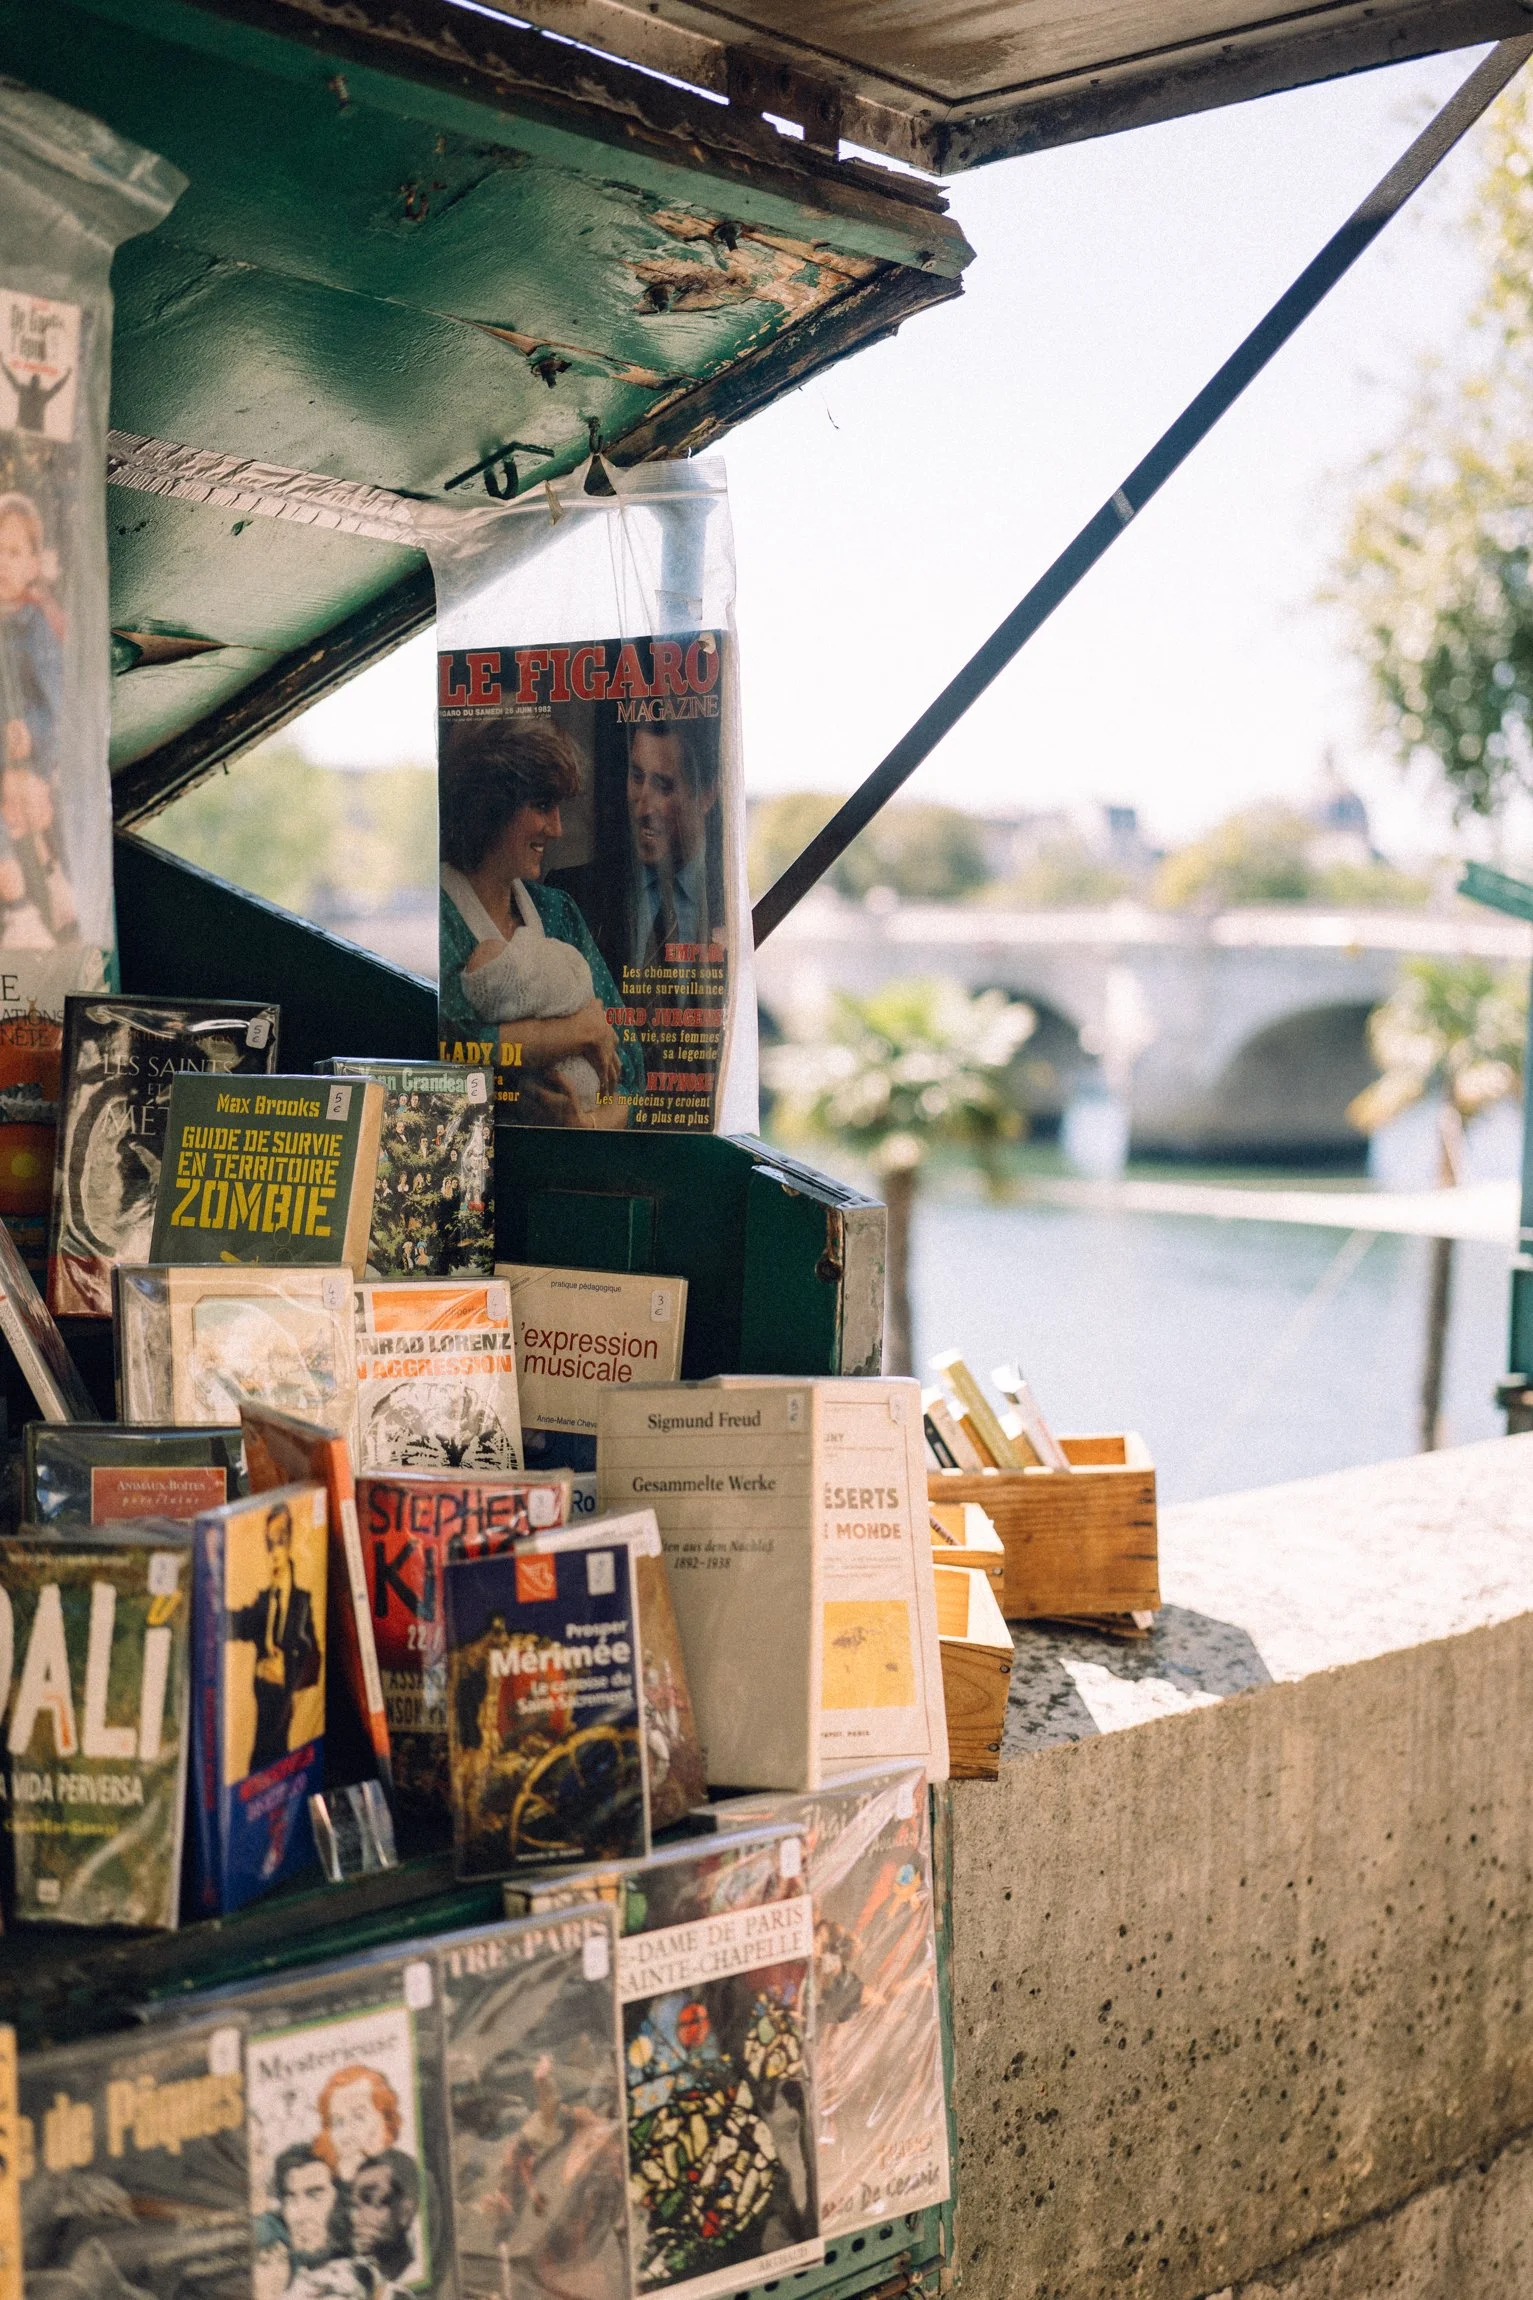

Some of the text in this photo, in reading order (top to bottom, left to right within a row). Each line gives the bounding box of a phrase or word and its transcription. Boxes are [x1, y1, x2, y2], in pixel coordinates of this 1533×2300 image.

[438, 640, 720, 707] LE FIGARO
[475, 708, 502, 716] SAMEDI
[515, 706, 532, 714] JUIN
[534, 705, 551, 713] 1982
[616, 695, 720, 723] MAGAZINE
[622, 965, 641, 978] Les
[699, 968, 724, 978] sous
[622, 982, 724, 995] haute surveillance
[605, 1007, 647, 1026] CURD
[623, 1029, 636, 1042] Sa
[680, 1030, 720, 1043] femmes
[439, 1041, 522, 1066] LADY DI
[662, 1050, 674, 1060] sa
[103, 1054, 140, 1077] LES
[470, 1078, 478, 1088] 5
[646, 1072, 715, 1091] HYPNOSE
[216, 1093, 321, 1118] Max Brooks
[334, 1092, 343, 1102] 5
[595, 1093, 614, 1105] Les
[666, 1096, 673, 1109] y
[675, 1095, 710, 1107] croient
[635, 1110, 709, 1126] de plus en plus
[181, 1126, 343, 1157] GUIDE DE SURVIE
[177, 1151, 340, 1186] EN TERRITOIRE
[170, 1178, 337, 1237] ZOMBIE
[550, 1280, 622, 1293] pratique pédagogique
[657, 1295, 664, 1306] 3
[428, 1333, 512, 1353] LORENZ
[372, 1355, 512, 1379] AGGRESSION
[523, 1354, 632, 1383] musicale
[536, 1414, 576, 1426] Anne-Marie
[647, 1409, 762, 1432] Sigmund Freud
[632, 1475, 776, 1493] Gesammelte Werke
[836, 1523, 901, 1540] MONDE
[683, 1543, 700, 1552] aus
[703, 1539, 727, 1552] dem
[488, 1634, 631, 1678] Mérimée
[57, 1772, 144, 1806] PERVERSA
[707, 1921, 735, 1946] DE
[745, 1907, 803, 1937] PARIS
